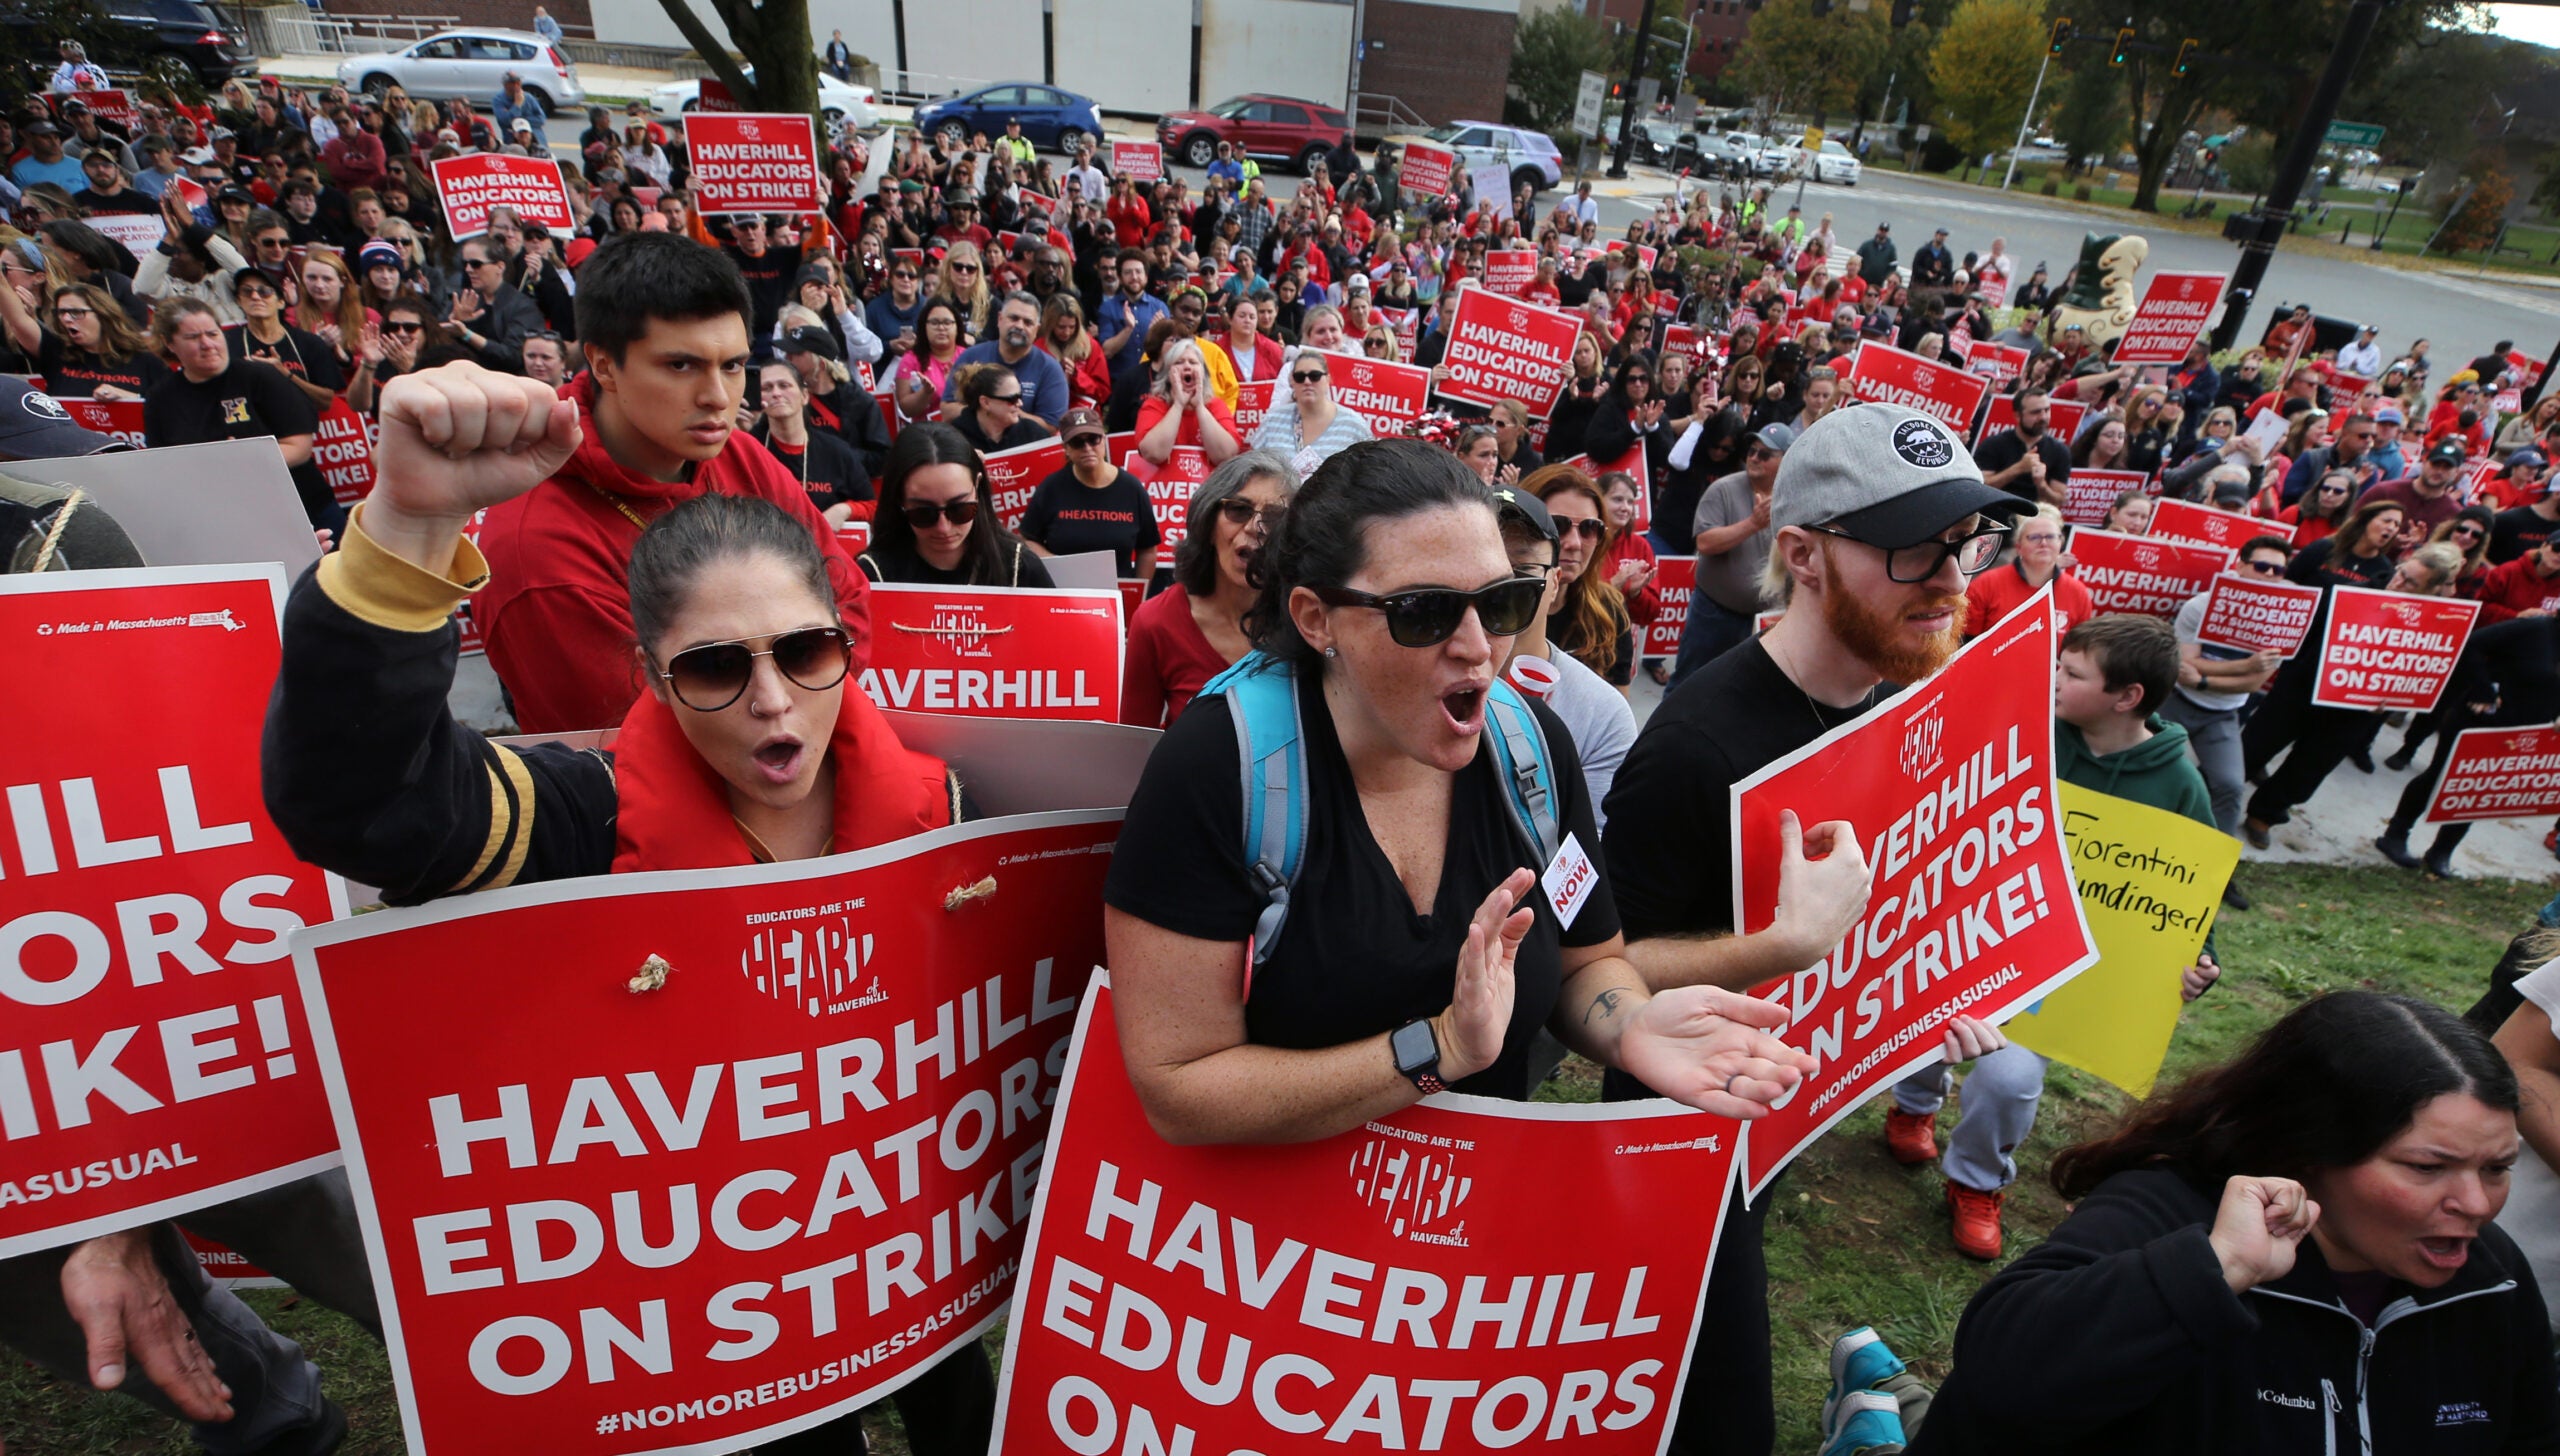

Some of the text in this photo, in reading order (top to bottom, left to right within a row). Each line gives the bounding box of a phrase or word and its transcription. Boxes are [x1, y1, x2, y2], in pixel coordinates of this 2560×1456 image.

[697, 143, 806, 160] HAVERHILL
[1405, 156, 1447, 173] HAVERHILL
[446, 174, 556, 191] HAVERHILL
[695, 163, 813, 180] EDUCATORS
[446, 187, 563, 208] EDUCATORS
[703, 182, 811, 199] ON STRIKE!
[455, 205, 486, 222] ON
[1489, 265, 1534, 274] HAVERHILL
[2141, 299, 2209, 316] HAVERHILL
[2129, 317, 2204, 333] EDUCATORS
[1460, 320, 1563, 364] HAVERHILL
[2123, 335, 2143, 350] ON
[1450, 341, 1563, 385] EDUCATORS
[1450, 364, 1481, 386] ON
[1481, 372, 1553, 403] STRIKE!
[1857, 376, 1964, 427] HAVERHILL
[2067, 478, 2138, 489] SUPPORT OUR
[1058, 509, 1134, 522] #HEASTRONG
[2073, 564, 2203, 596] HAVERHILL
[2218, 586, 2313, 611] SUPPORT OUR
[56, 622, 90, 635] Made
[92, 620, 104, 632] in
[106, 615, 188, 631] Massachusetts
[2209, 612, 2304, 638] BY SUPPORTING
[2214, 598, 2309, 627] STUDENTS
[2206, 623, 2235, 637] OUR
[2338, 622, 2455, 652] HAVERHILL
[2328, 645, 2452, 674] EDUCATORS
[2329, 668, 2439, 695] ON STRIKE!
[2441, 795, 2477, 811] ON
[2063, 810, 2200, 887] Fiorentini
[1555, 858, 1589, 914] NOW
[746, 897, 866, 926] EDUCATORS ARE THE
[2072, 865, 2211, 944] umdinger!
[1853, 864, 2051, 1041] STRIKE!
[866, 975, 880, 997] of
[828, 990, 890, 1016] HAVERHILL
[1809, 962, 2023, 1118] #NOMOREBUSINESSASUSUAL
[428, 957, 1076, 1179] HAVERHILL
[1366, 1121, 1476, 1151] EDUCATORS ARE THE
[412, 1033, 1075, 1296] EDUCATORS
[1409, 1231, 1470, 1248] HAVERHILL
[1449, 1219, 1465, 1241] of
[1085, 1160, 1662, 1350] HAVERHILL
[467, 1298, 675, 1397] ON
[595, 1258, 1019, 1436] #NOMOREBUSINESSASUSUAL
[1041, 1255, 1665, 1450] EDUCATORS
[2262, 1389, 2316, 1411] Columbia
[2437, 1401, 2481, 1414] UNIVERSITY
[2435, 1409, 2489, 1423] OF HARTFORD
